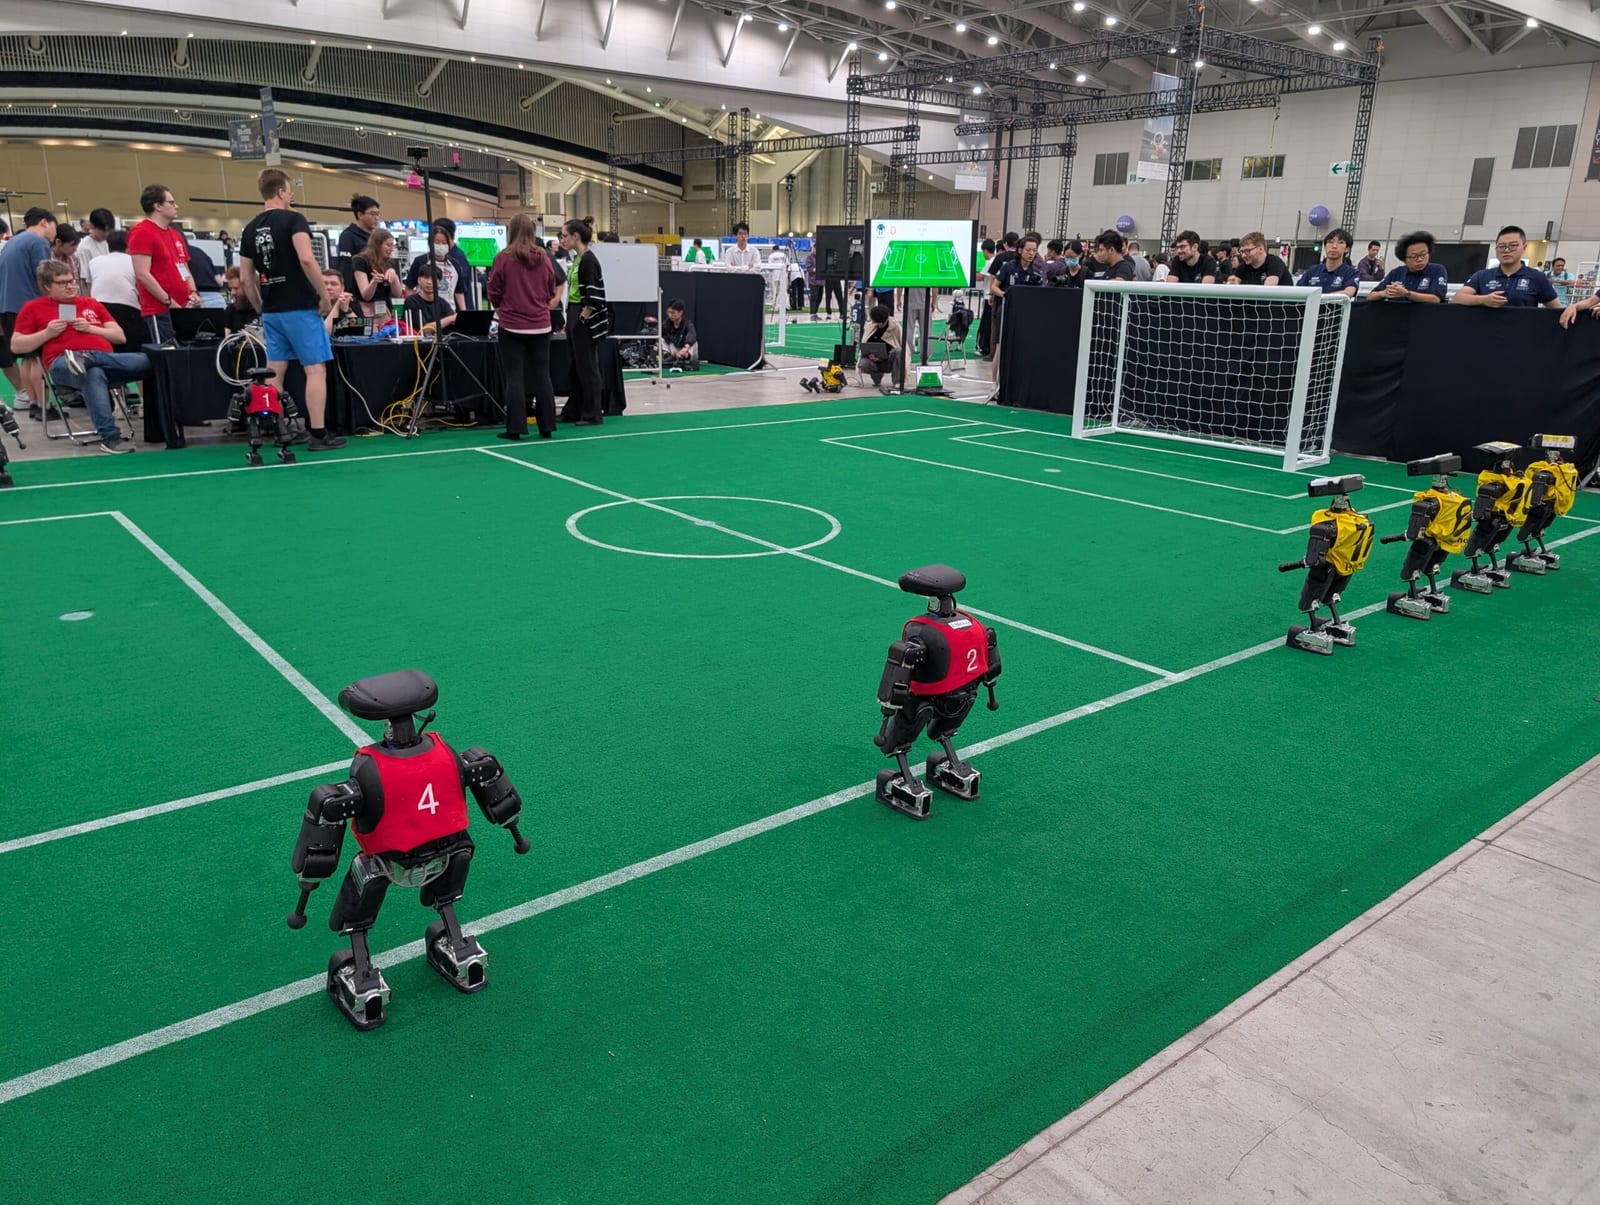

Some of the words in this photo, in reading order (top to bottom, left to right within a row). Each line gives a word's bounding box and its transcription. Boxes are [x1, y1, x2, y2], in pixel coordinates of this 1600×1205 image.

[852, 308, 858, 321] 5
[262, 392, 270, 408] 1
[966, 648, 978, 673] 2
[417, 782, 440, 815] 4
